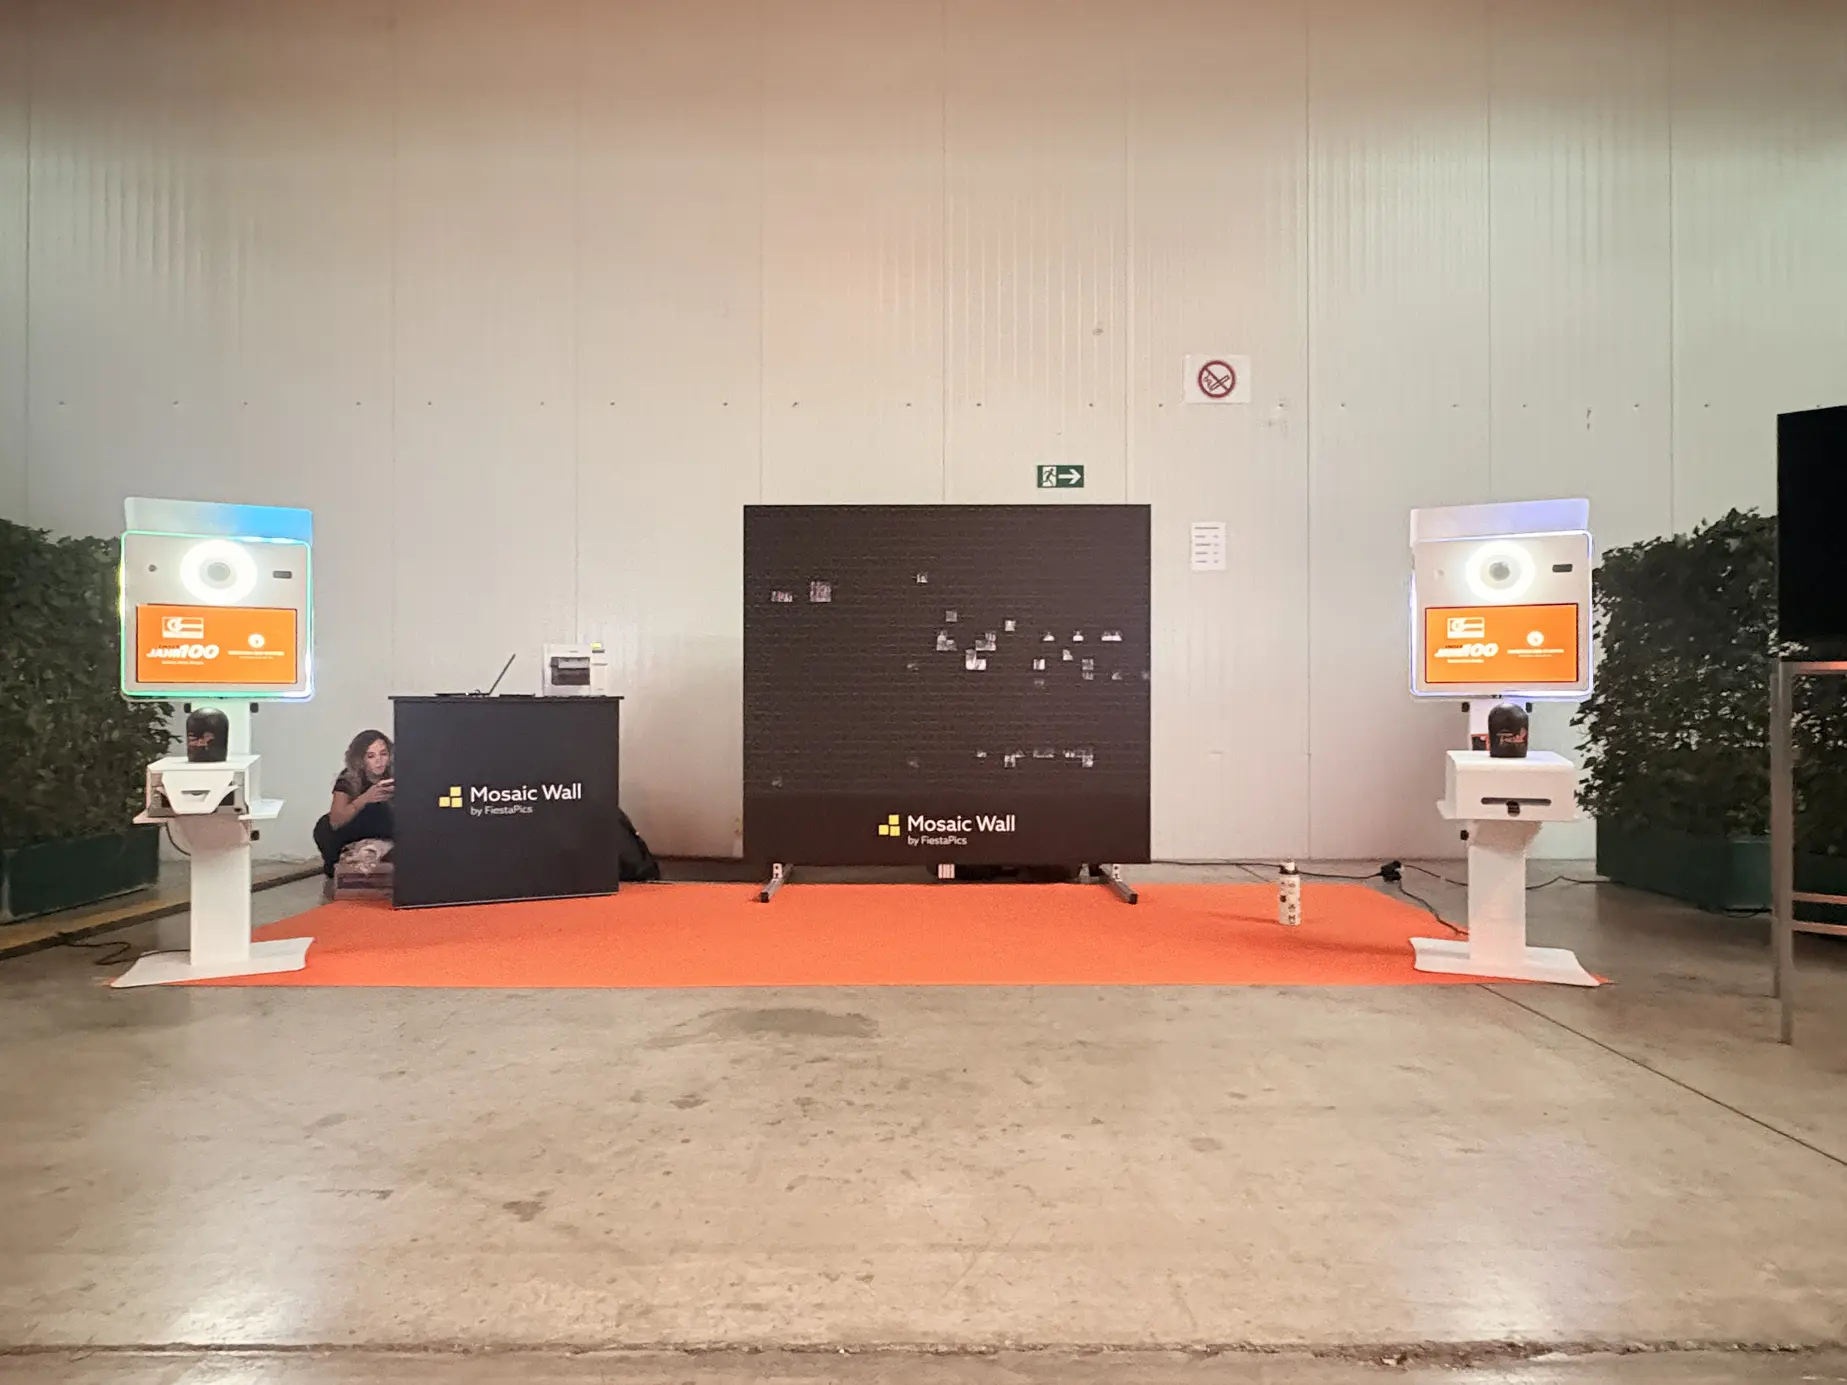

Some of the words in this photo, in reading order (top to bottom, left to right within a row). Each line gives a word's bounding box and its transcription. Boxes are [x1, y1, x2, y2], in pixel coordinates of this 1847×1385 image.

[470, 785, 538, 802] Mosaic
[542, 783, 582, 800] Wall
[470, 806, 483, 817] by
[484, 806, 533, 815] FiestaPics
[907, 815, 972, 832] Mosaic
[976, 814, 1015, 831] Wall
[907, 835, 920, 847] by
[921, 836, 968, 845] FiestaPics
